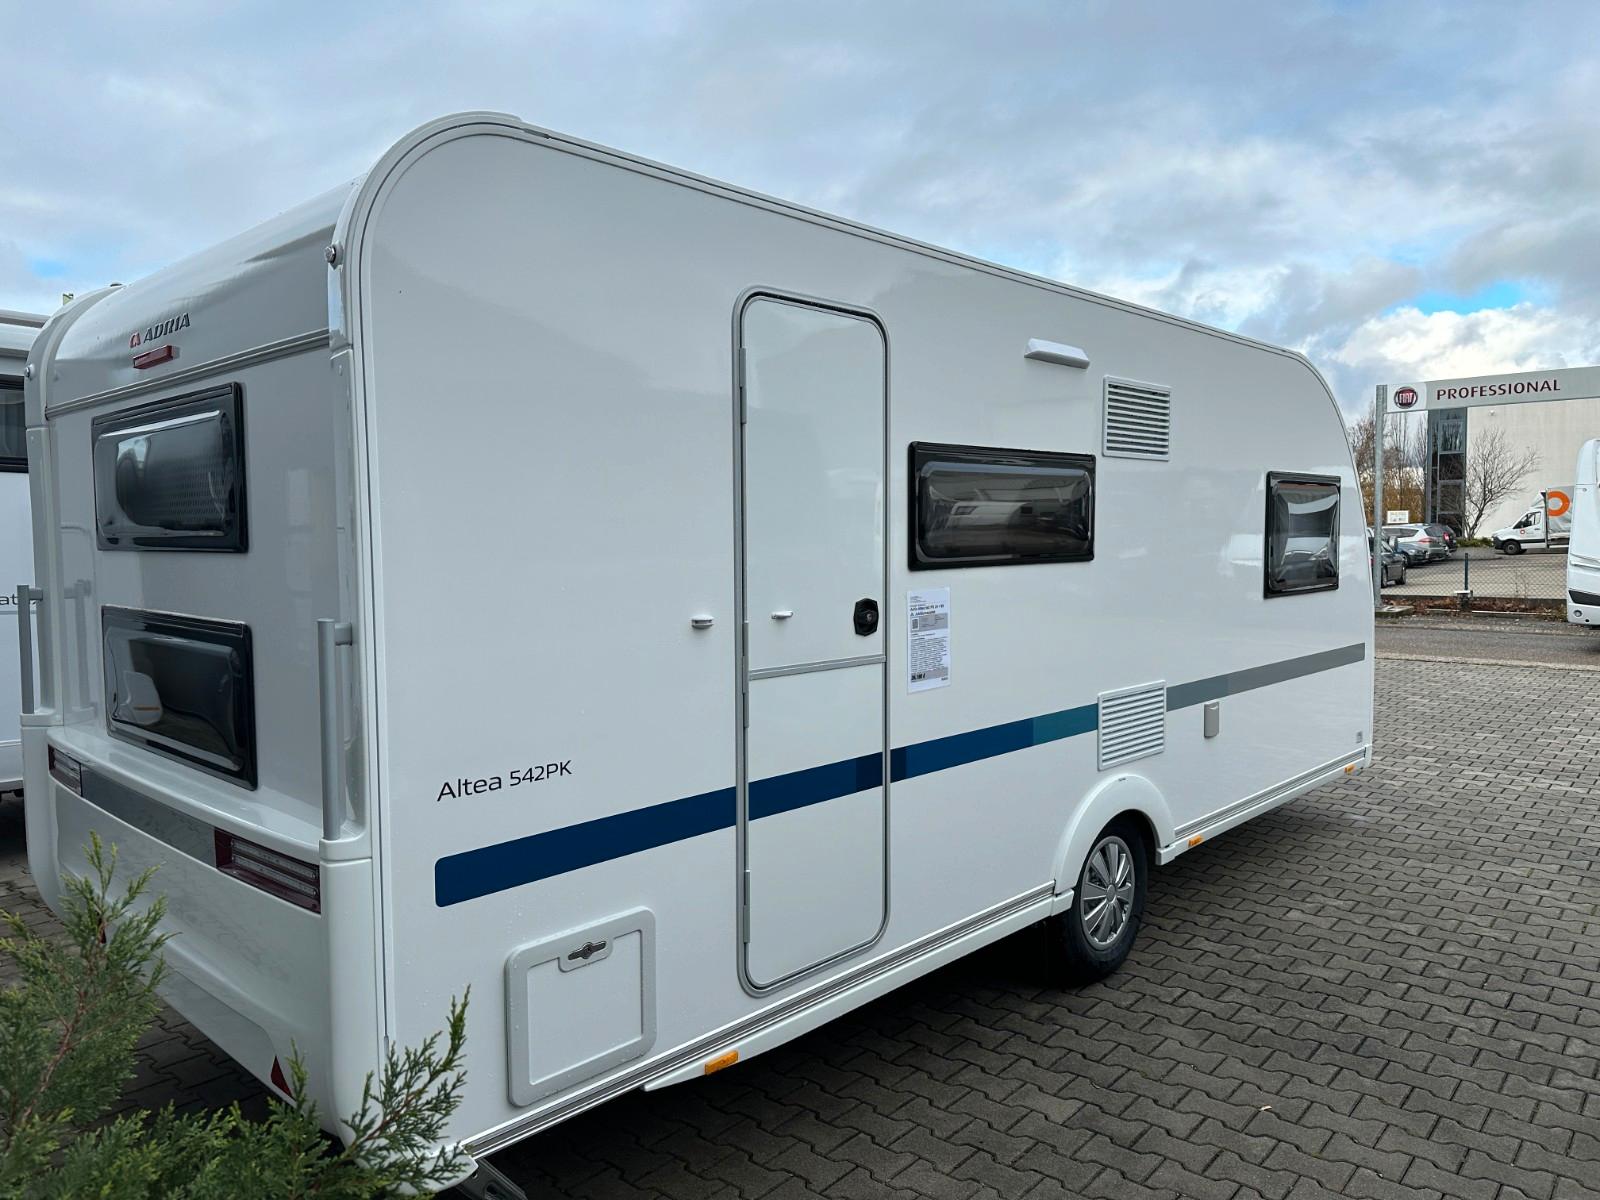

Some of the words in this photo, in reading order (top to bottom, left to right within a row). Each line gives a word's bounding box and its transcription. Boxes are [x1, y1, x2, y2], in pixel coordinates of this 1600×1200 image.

[143, 312, 190, 344] ADRIA
[1436, 379, 1561, 401] PROFESSIONAL
[437, 776, 502, 802] Altea
[509, 760, 572, 787] 542PK
